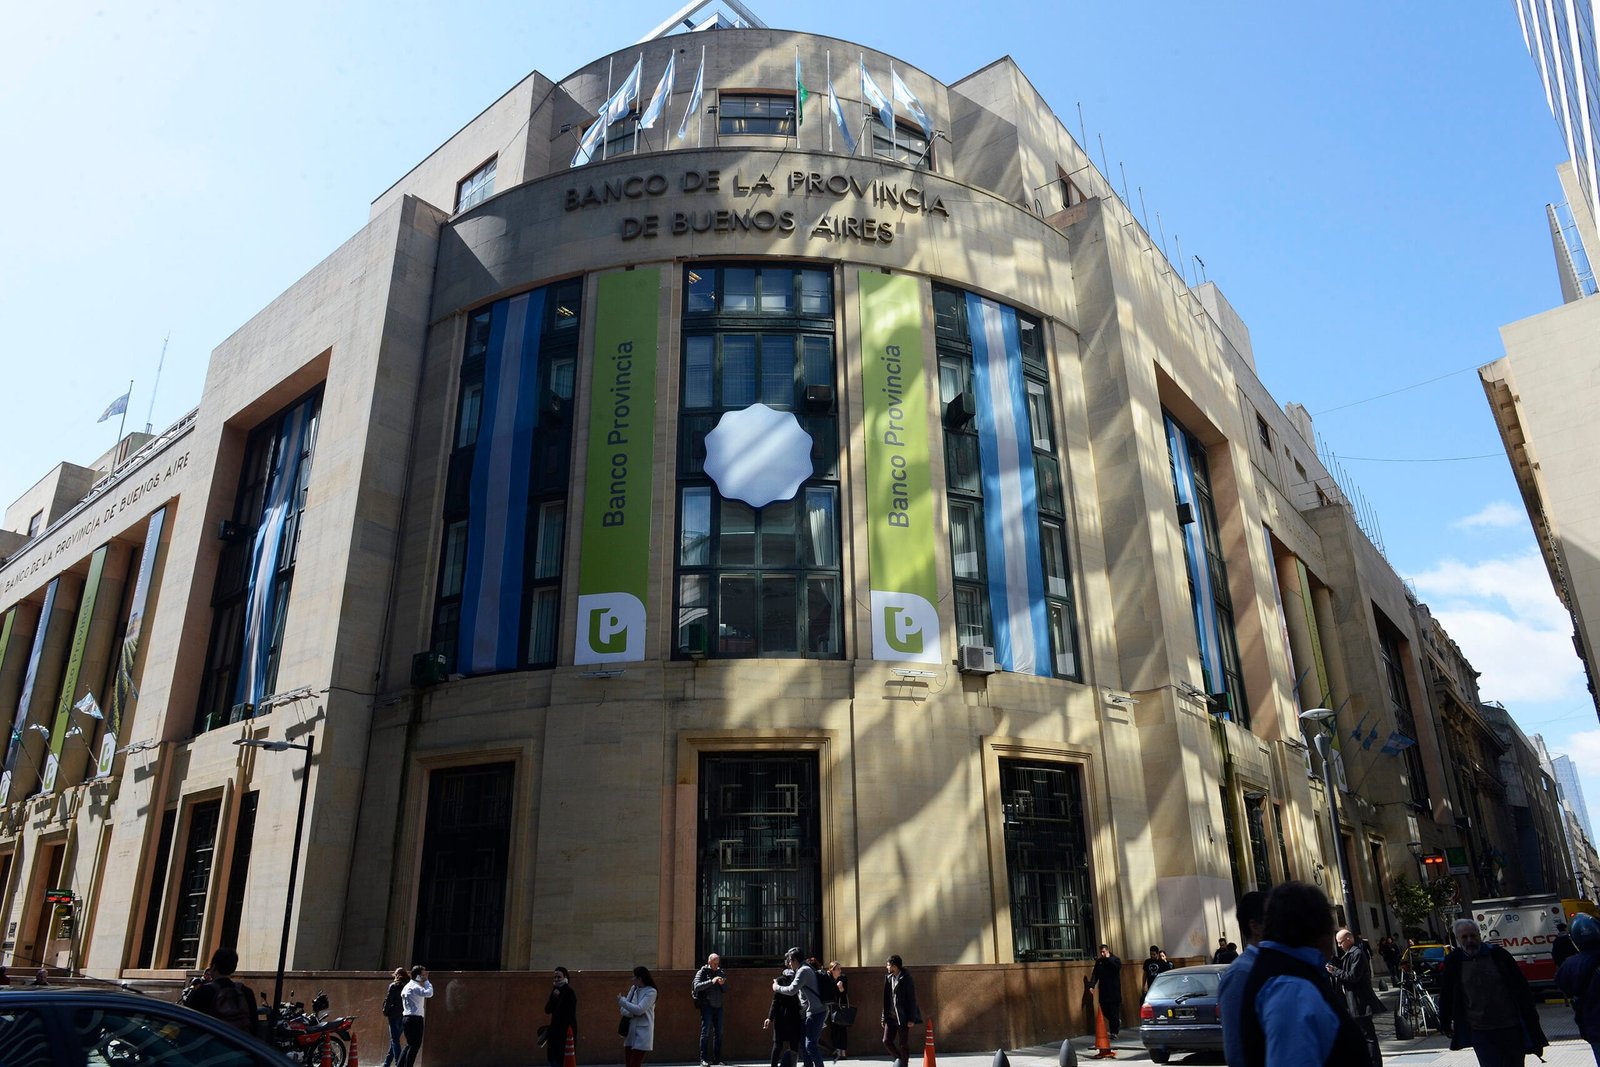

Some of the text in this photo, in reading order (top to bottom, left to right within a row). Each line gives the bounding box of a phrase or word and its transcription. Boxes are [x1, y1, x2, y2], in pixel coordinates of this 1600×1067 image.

[565, 168, 950, 217] BANCO DE LA PROVINCIA
[621, 208, 895, 243] DE BUENOS AIRES
[602, 340, 633, 528] Banco Provincia
[882, 344, 910, 528] Banco Provincia
[5, 450, 191, 593] BANCO DE LA PROVINCIA DE BUENOS AIRE
